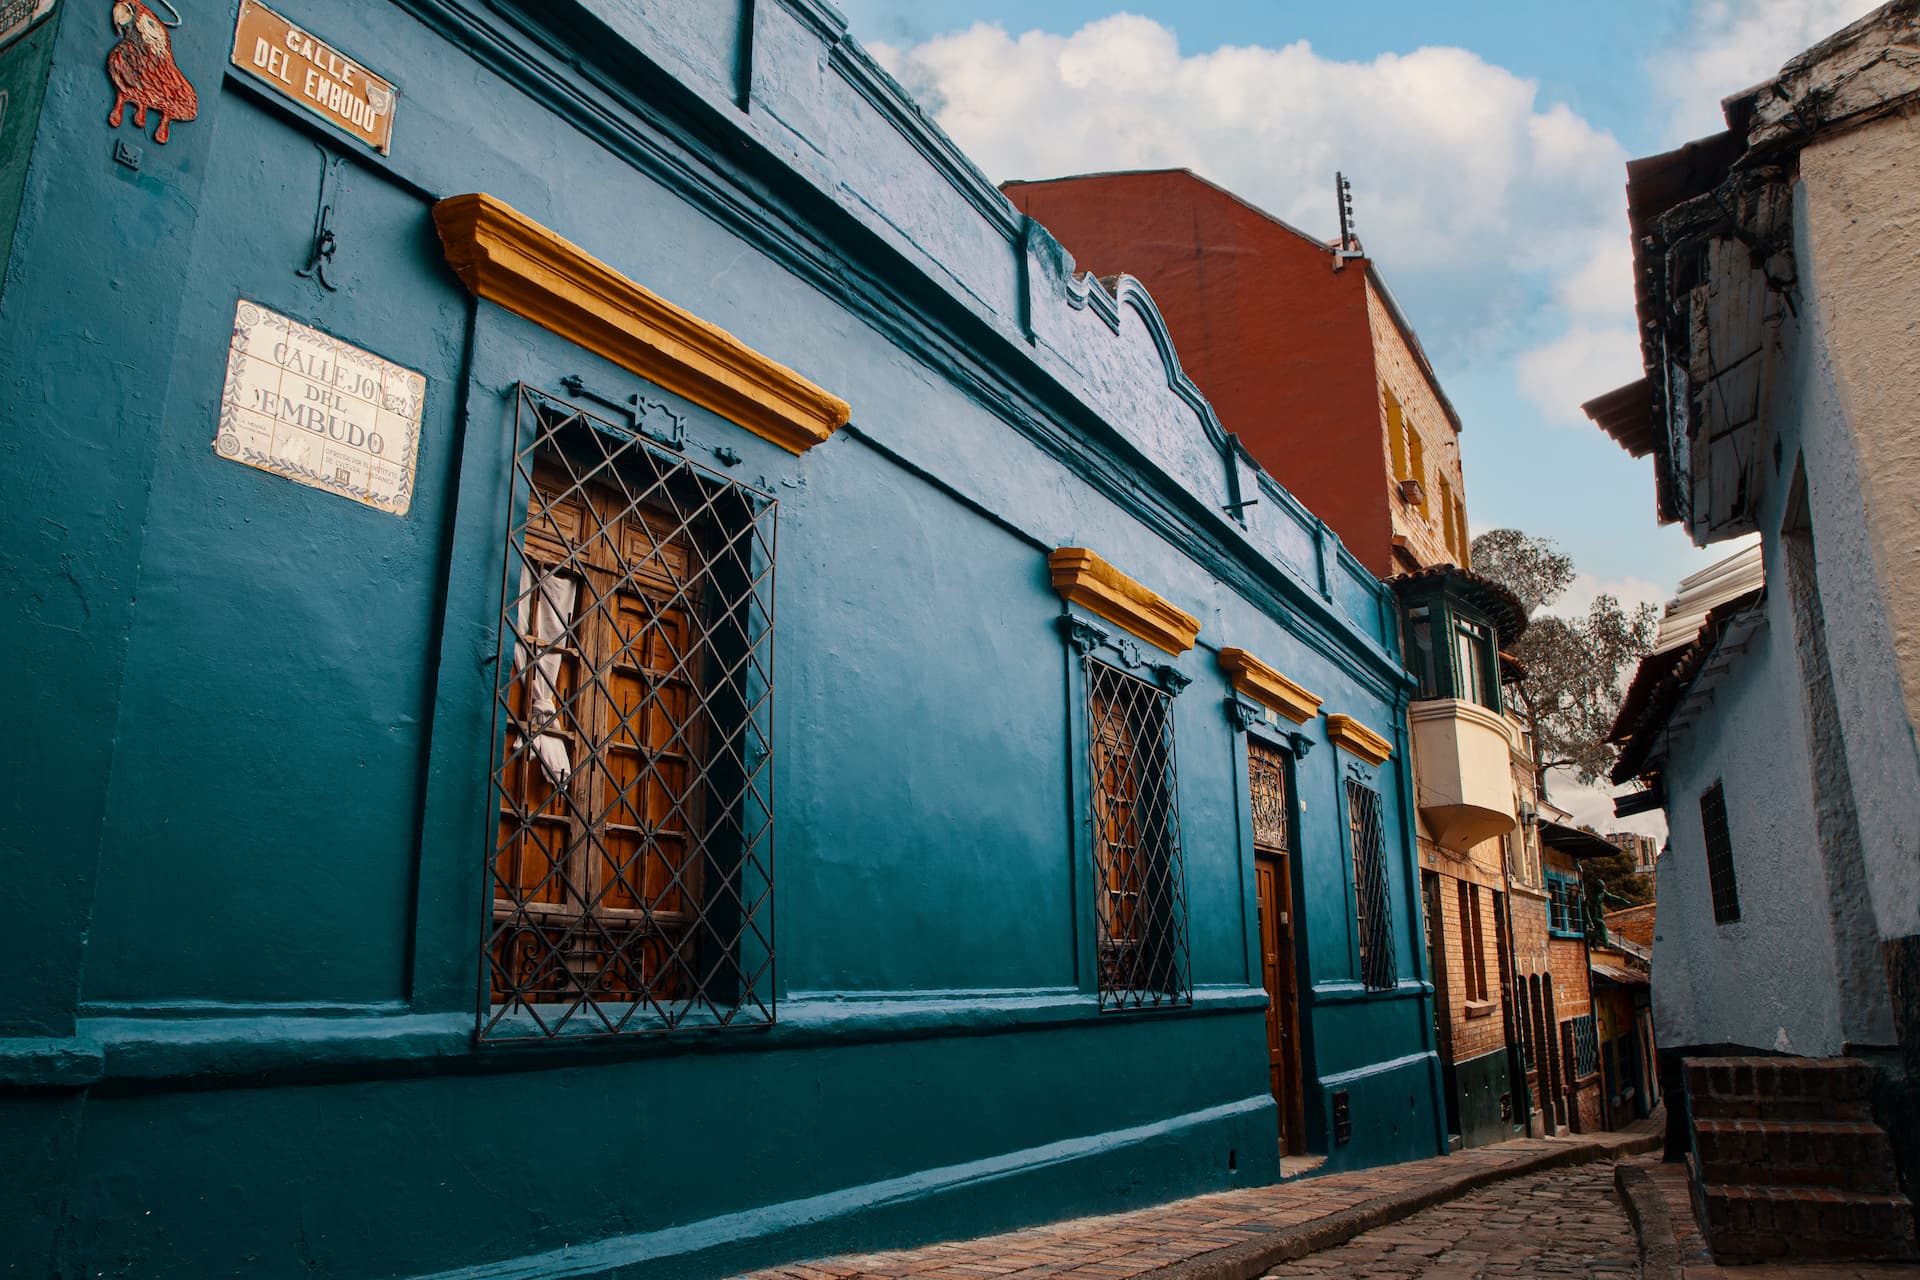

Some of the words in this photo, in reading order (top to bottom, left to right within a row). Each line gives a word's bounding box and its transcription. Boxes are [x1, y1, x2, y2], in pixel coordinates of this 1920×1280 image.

[253, 36, 292, 85] DEL
[303, 67, 377, 134] EMBUDO
[286, 29, 358, 88] CALLE
[258, 388, 384, 455] EMBUDO
[303, 383, 347, 414] DEL
